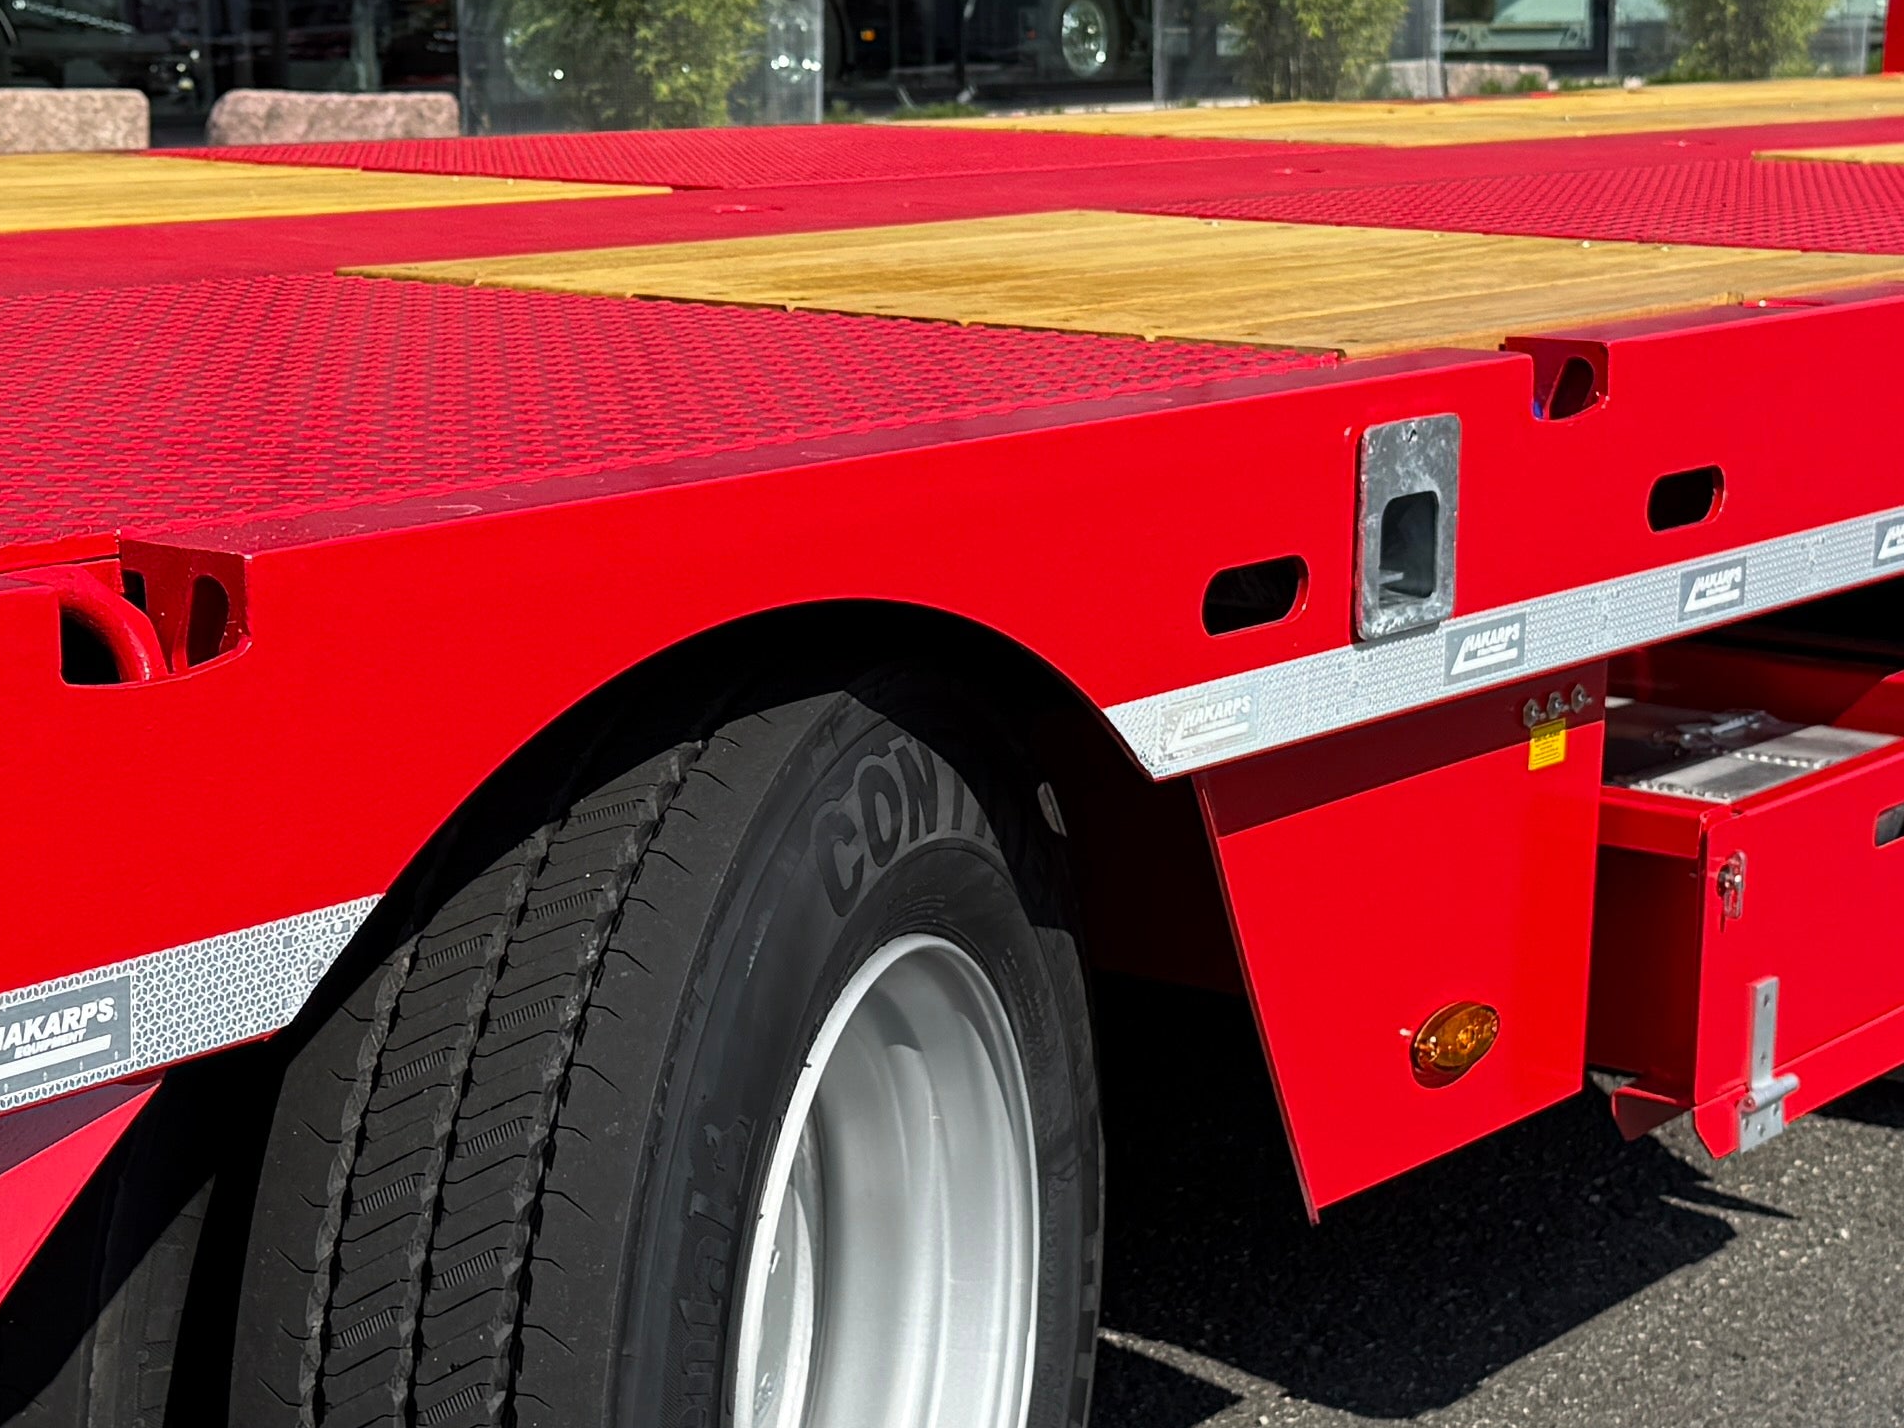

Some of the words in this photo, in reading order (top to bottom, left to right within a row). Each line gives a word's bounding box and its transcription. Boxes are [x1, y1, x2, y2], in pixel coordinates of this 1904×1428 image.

[1464, 622, 1521, 651] HAKARPS
[1183, 694, 1253, 729] HAKARPS
[13, 1028, 87, 1059] EQUIPMENT
